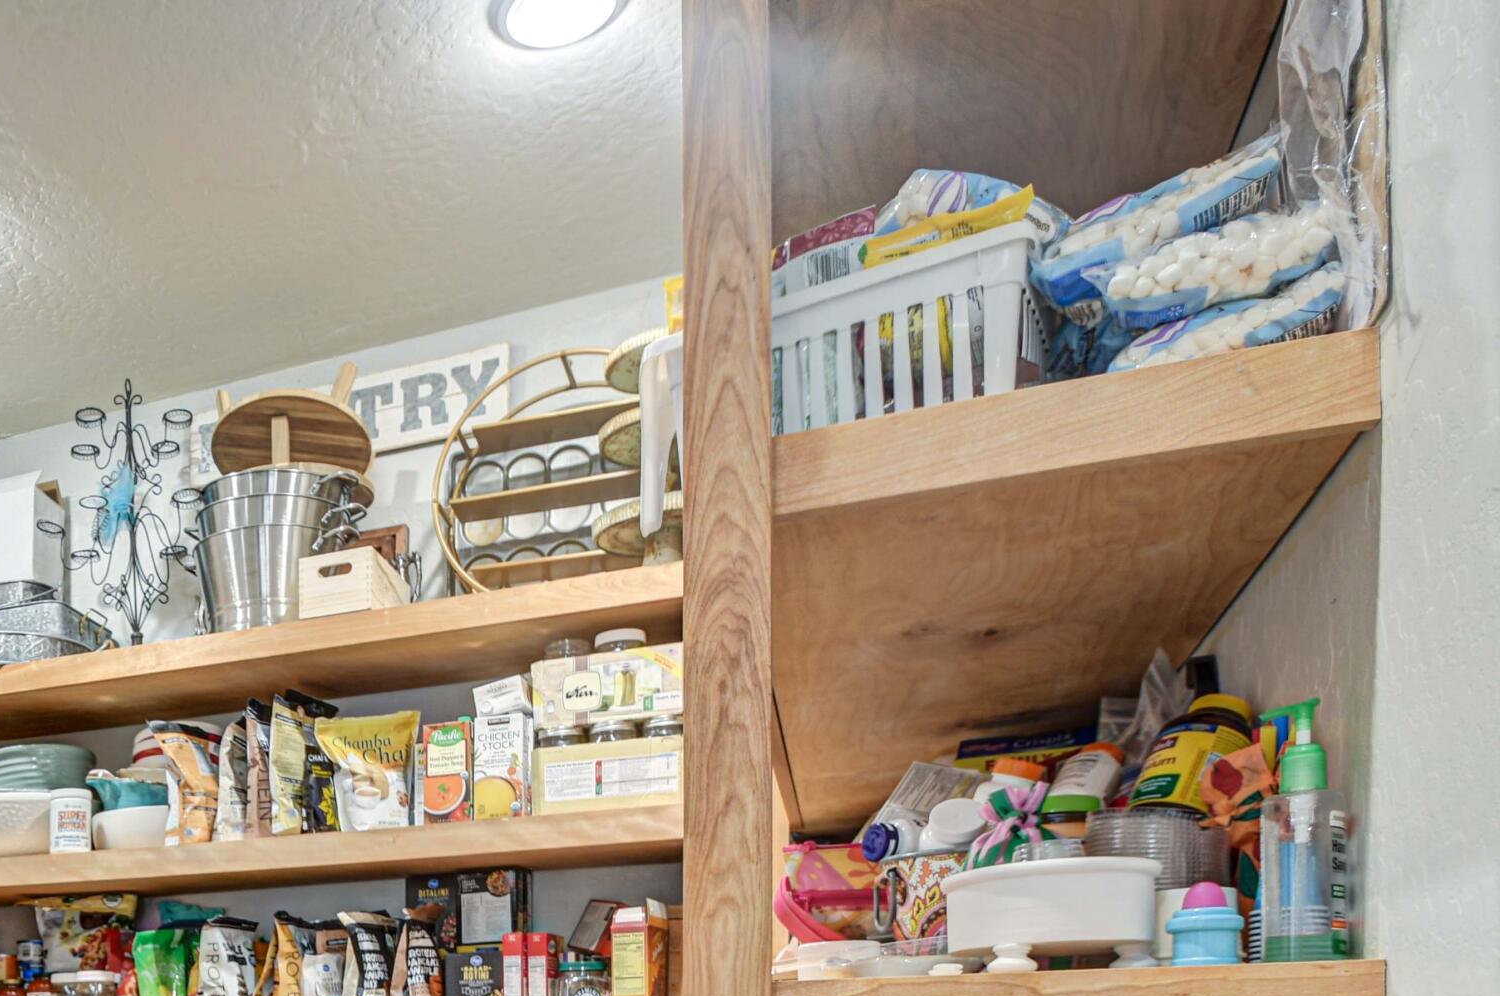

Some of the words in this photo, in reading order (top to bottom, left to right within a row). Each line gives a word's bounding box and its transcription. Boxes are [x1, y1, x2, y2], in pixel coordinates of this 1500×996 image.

[478, 731, 520, 742] CHICKEN
[332, 734, 392, 750] Chamba
[482, 741, 514, 751] STOCK
[58, 810, 87, 819] SUPER
[418, 888, 449, 898] DITALINI
[463, 971, 489, 980] ROTINI
